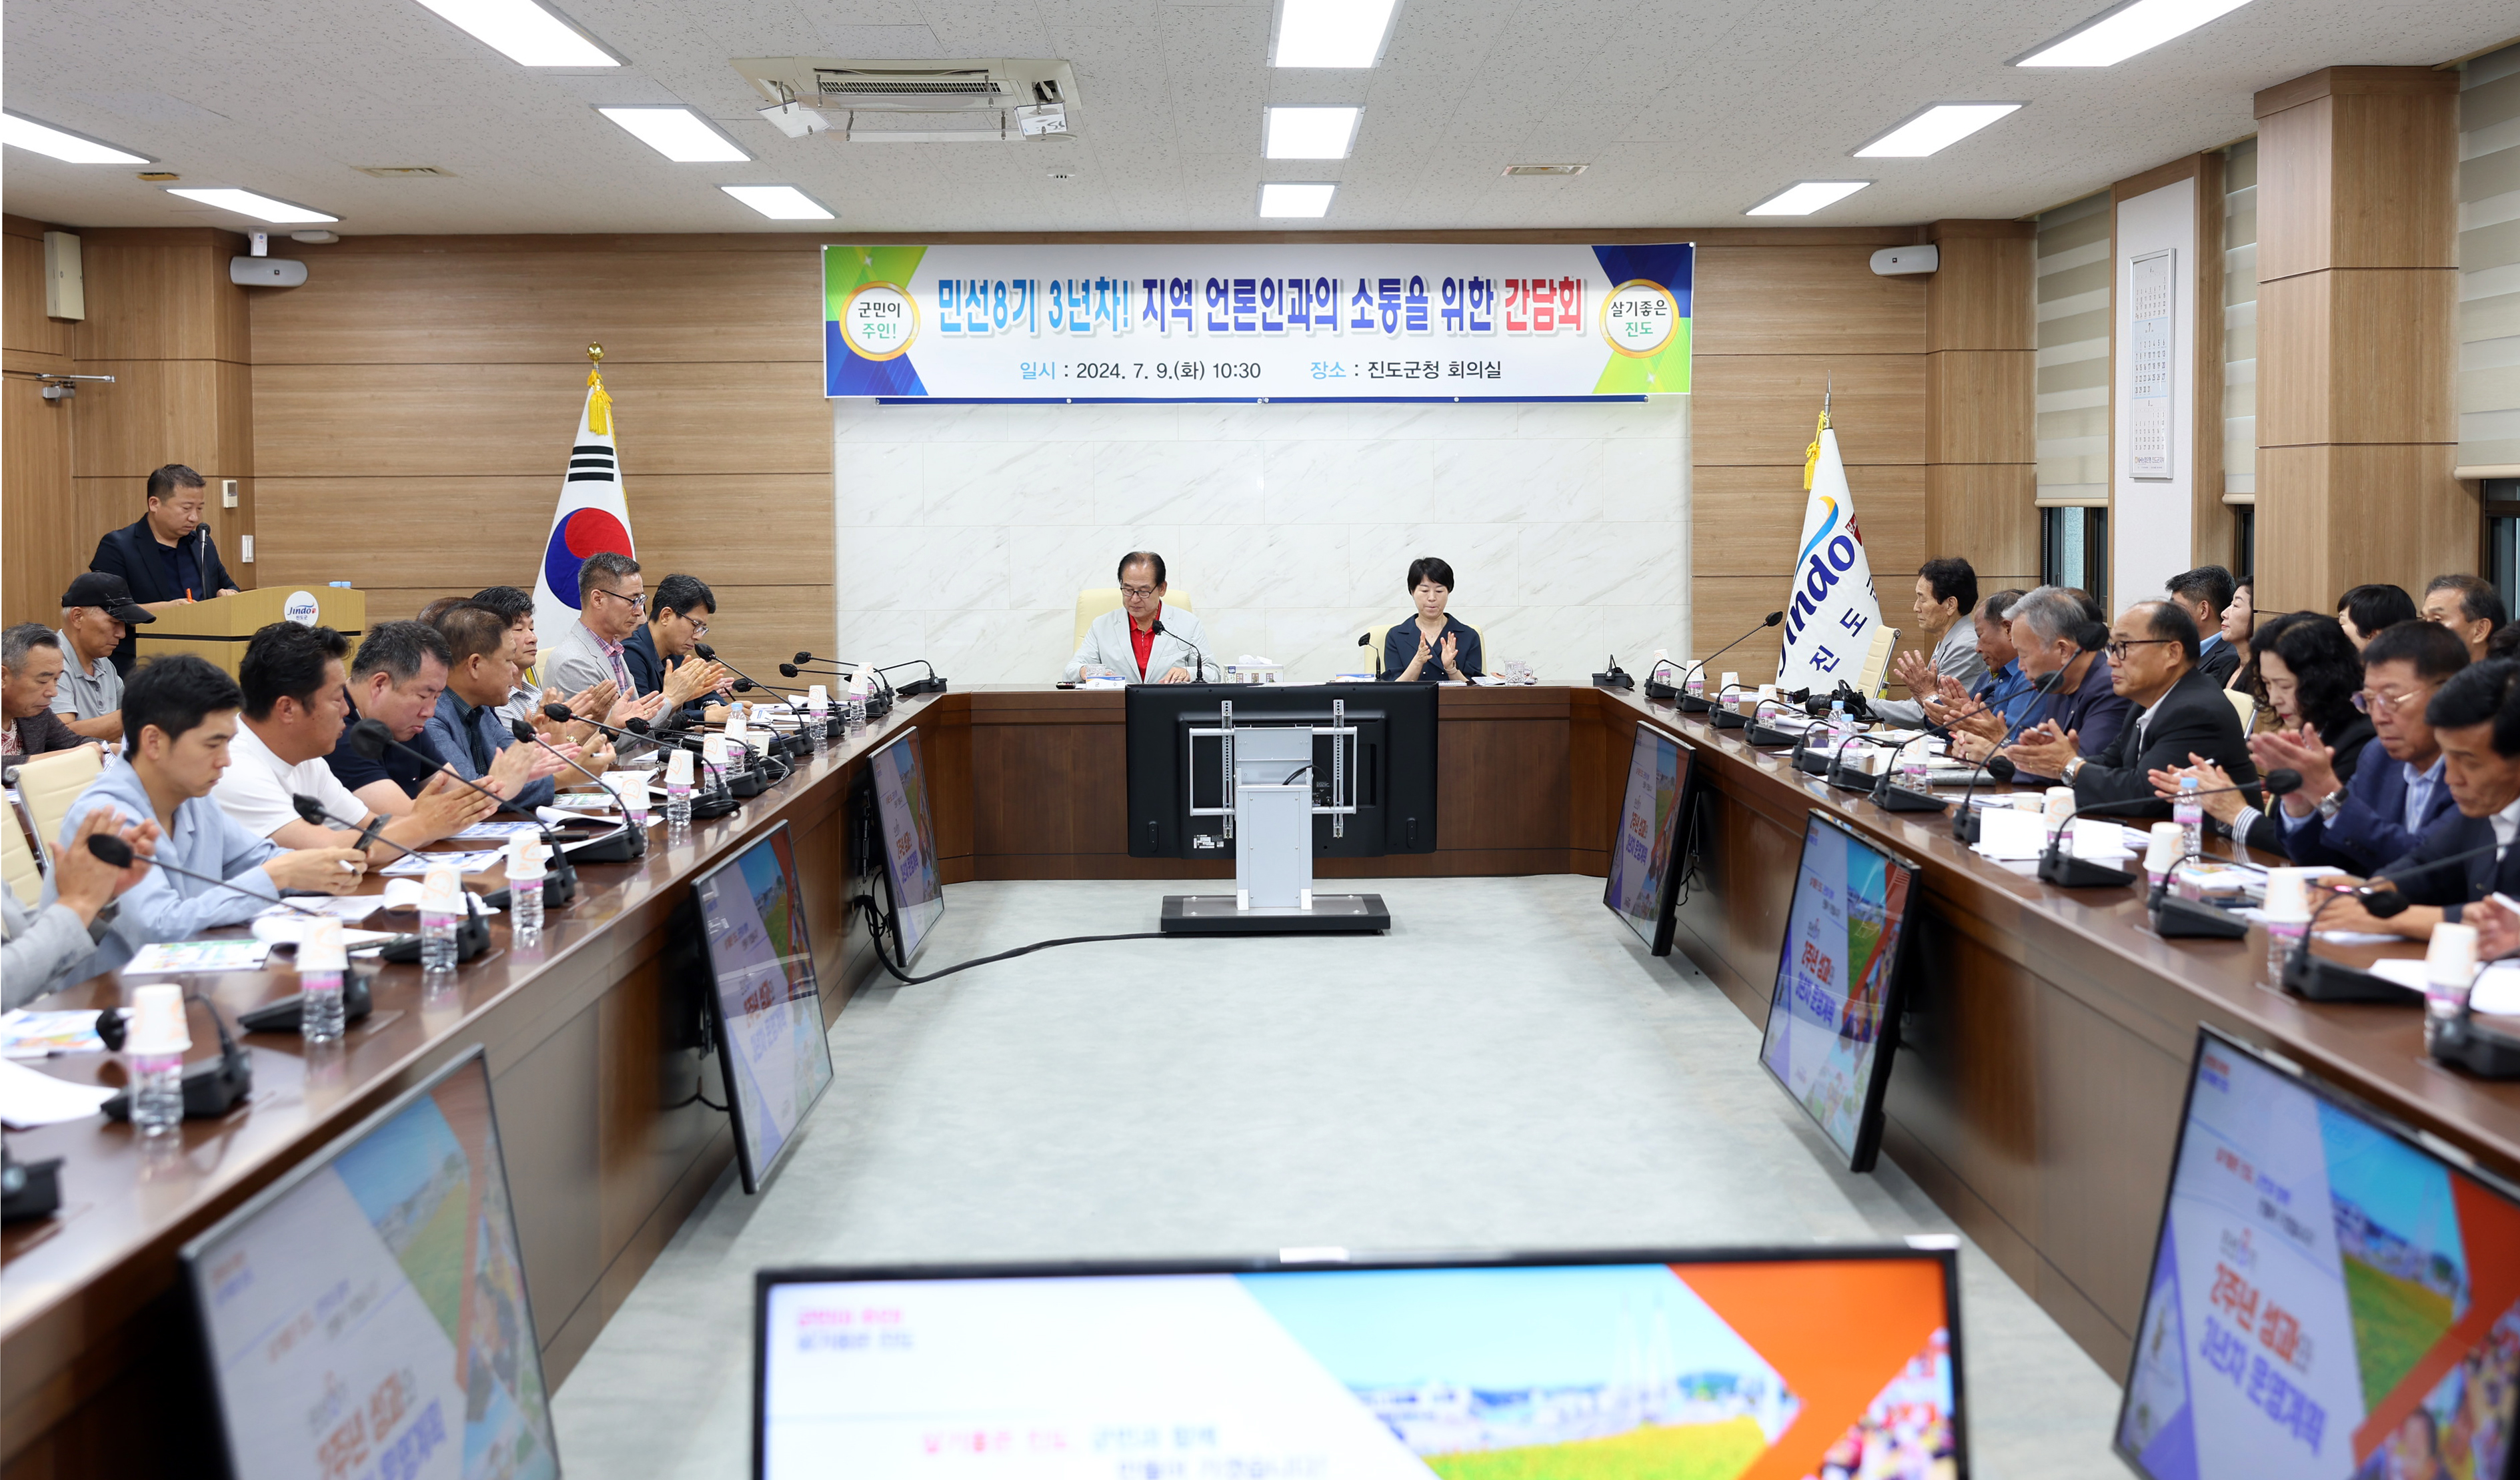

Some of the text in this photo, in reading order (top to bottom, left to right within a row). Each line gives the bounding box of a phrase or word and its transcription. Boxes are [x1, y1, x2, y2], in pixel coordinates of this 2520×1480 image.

[858, 301, 901, 318] 군민이
[939, 276, 1581, 333] 민선8기 3년차! 지역 언론인과의 소통을 위한 간담회
[1610, 299, 1668, 317] 살기좋은
[862, 323, 896, 339] 주인!
[1625, 321, 1654, 337] 진도
[2148, 322, 2151, 333] 7
[1020, 361, 1055, 380] 일시
[1076, 362, 1126, 380] 2024.
[1133, 363, 1148, 380] 7.
[1156, 360, 1205, 381] 9.(화)
[1213, 362, 1261, 379] 10:30
[1310, 361, 1346, 380] 장소
[1368, 361, 1439, 380] 진도군청
[1448, 360, 1501, 380] 회의실
[287, 607, 311, 616] Jindo
[2210, 1261, 2261, 1333] 2주년
